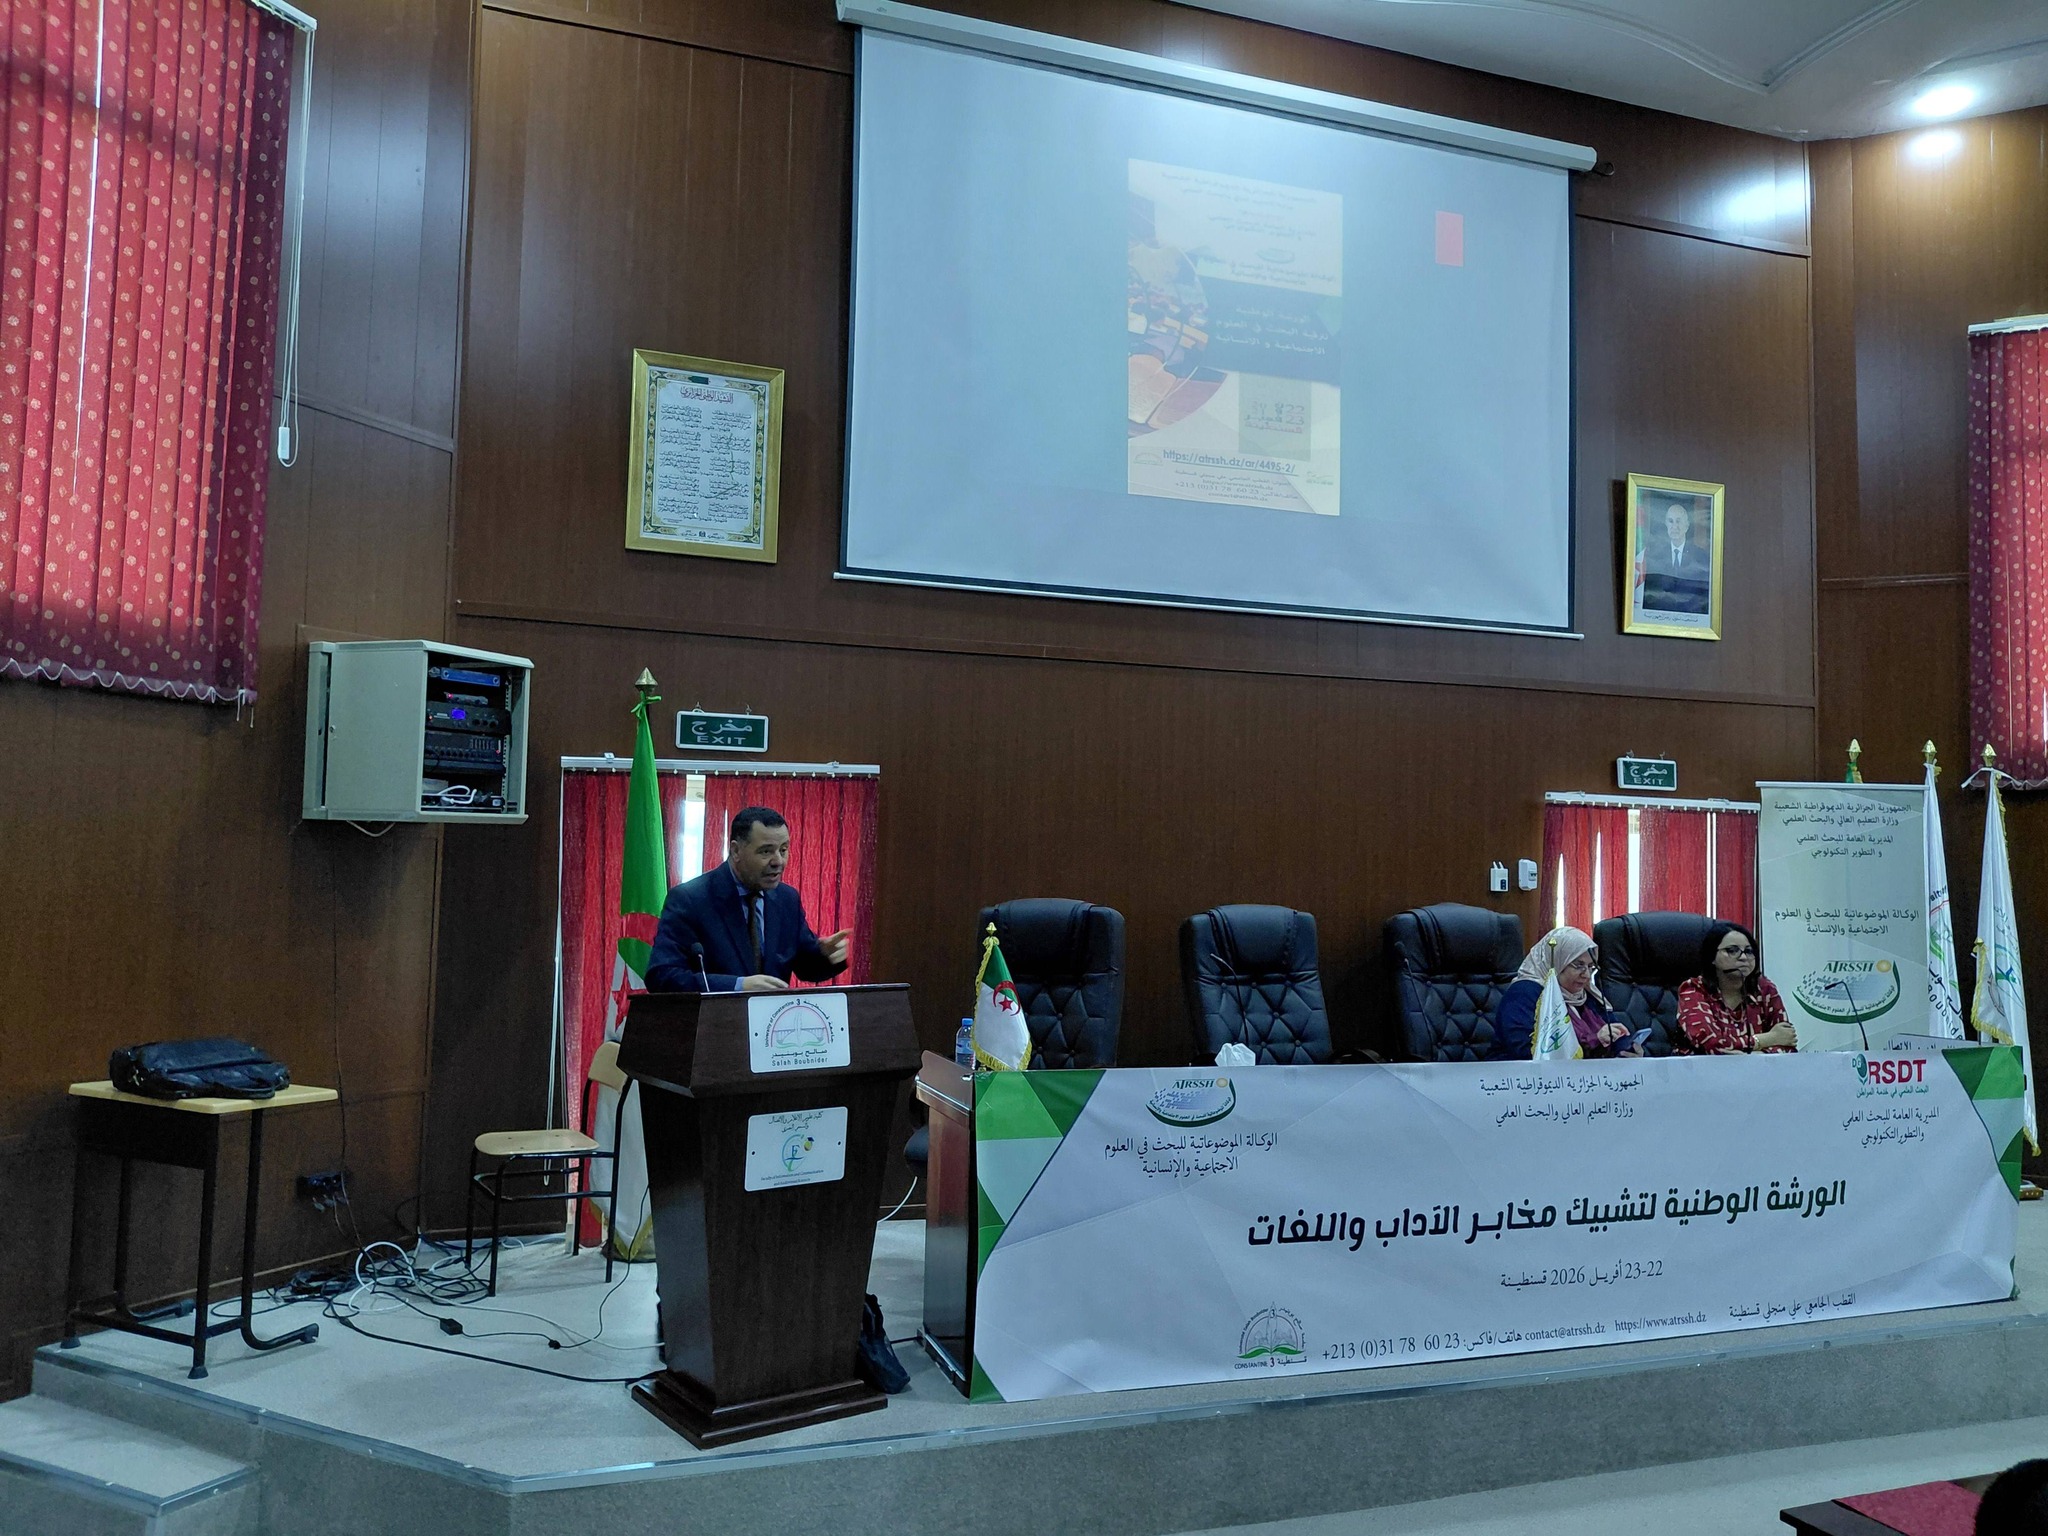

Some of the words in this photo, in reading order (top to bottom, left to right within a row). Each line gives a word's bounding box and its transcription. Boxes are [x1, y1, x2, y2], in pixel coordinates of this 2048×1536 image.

[691, 719, 753, 736] مخرج
[697, 735, 746, 745] EXIT
[1630, 764, 1668, 777] مخرج
[1633, 777, 1664, 785] EXIT
[1775, 907, 1802, 921] العلوم
[1804, 909, 1812, 922] في
[1814, 907, 1841, 921] للبحث
[1892, 909, 1920, 922] الوكالة
[1848, 924, 1889, 936] الاجتماعية
[1868, 1059, 1927, 1085] RSDT
[1479, 1077, 1514, 1096] الشعبية
[1566, 1075, 1601, 1094] الجزائرية
[1603, 1074, 1644, 1093] الجمهورية
[1495, 1105, 1521, 1128] العلمي
[1524, 1103, 1559, 1122] والبحث
[1561, 1102, 1585, 1125] العالي
[1587, 1101, 1612, 1125] التعليم
[1614, 1100, 1634, 1118] وزارة
[1866, 1108, 1891, 1125] للبحث
[1892, 1107, 1913, 1121] العامة
[1915, 1106, 1940, 1124] المديرية
[1842, 1110, 1864, 1131] العلمي
[1104, 1137, 1134, 1160] العلوم
[1137, 1136, 1149, 1160] في
[1152, 1135, 1186, 1155] للبحث
[1190, 1133, 1243, 1154] الموضوعاتية
[1246, 1132, 1278, 1151] الوكالة
[1142, 1158, 1191, 1179] والإنسانية
[1194, 1156, 1239, 1175] الاجتماعية
[1664, 1185, 1760, 1226] الوطنية
[1766, 1176, 1847, 1219] الورشة
[1565, 1187, 1658, 1233] لتشبيك
[1248, 1208, 1366, 1252] واللغات
[1374, 1204, 1460, 1248] الآداب
[1464, 1198, 1558, 1245] مخابر
[1500, 1270, 1548, 1292] قسنطينة
[1550, 1265, 1586, 1286] 2026
[1588, 1258, 1623, 1287] أفريل
[1788, 1299, 1802, 1320] علي
[1805, 1296, 1830, 1319] الجامعي
[1832, 1292, 1857, 1310] القطب
[1614, 1311, 1708, 1333] https://www.atrssh.dz
[1729, 1303, 1761, 1321] قسنطينة
[1762, 1302, 1786, 1323] منجلي
[1524, 1322, 1606, 1341] contact@atrssh.dz
[1322, 1343, 1356, 1360] +213
[1360, 1338, 1395, 1360] (0)31
[1399, 1336, 1416, 1354] 78
[1423, 1333, 1440, 1351] 60
[1444, 1332, 1461, 1350] 23
[1234, 1361, 1268, 1369] CONSTANTINE
[1269, 1356, 1275, 1367] 3
